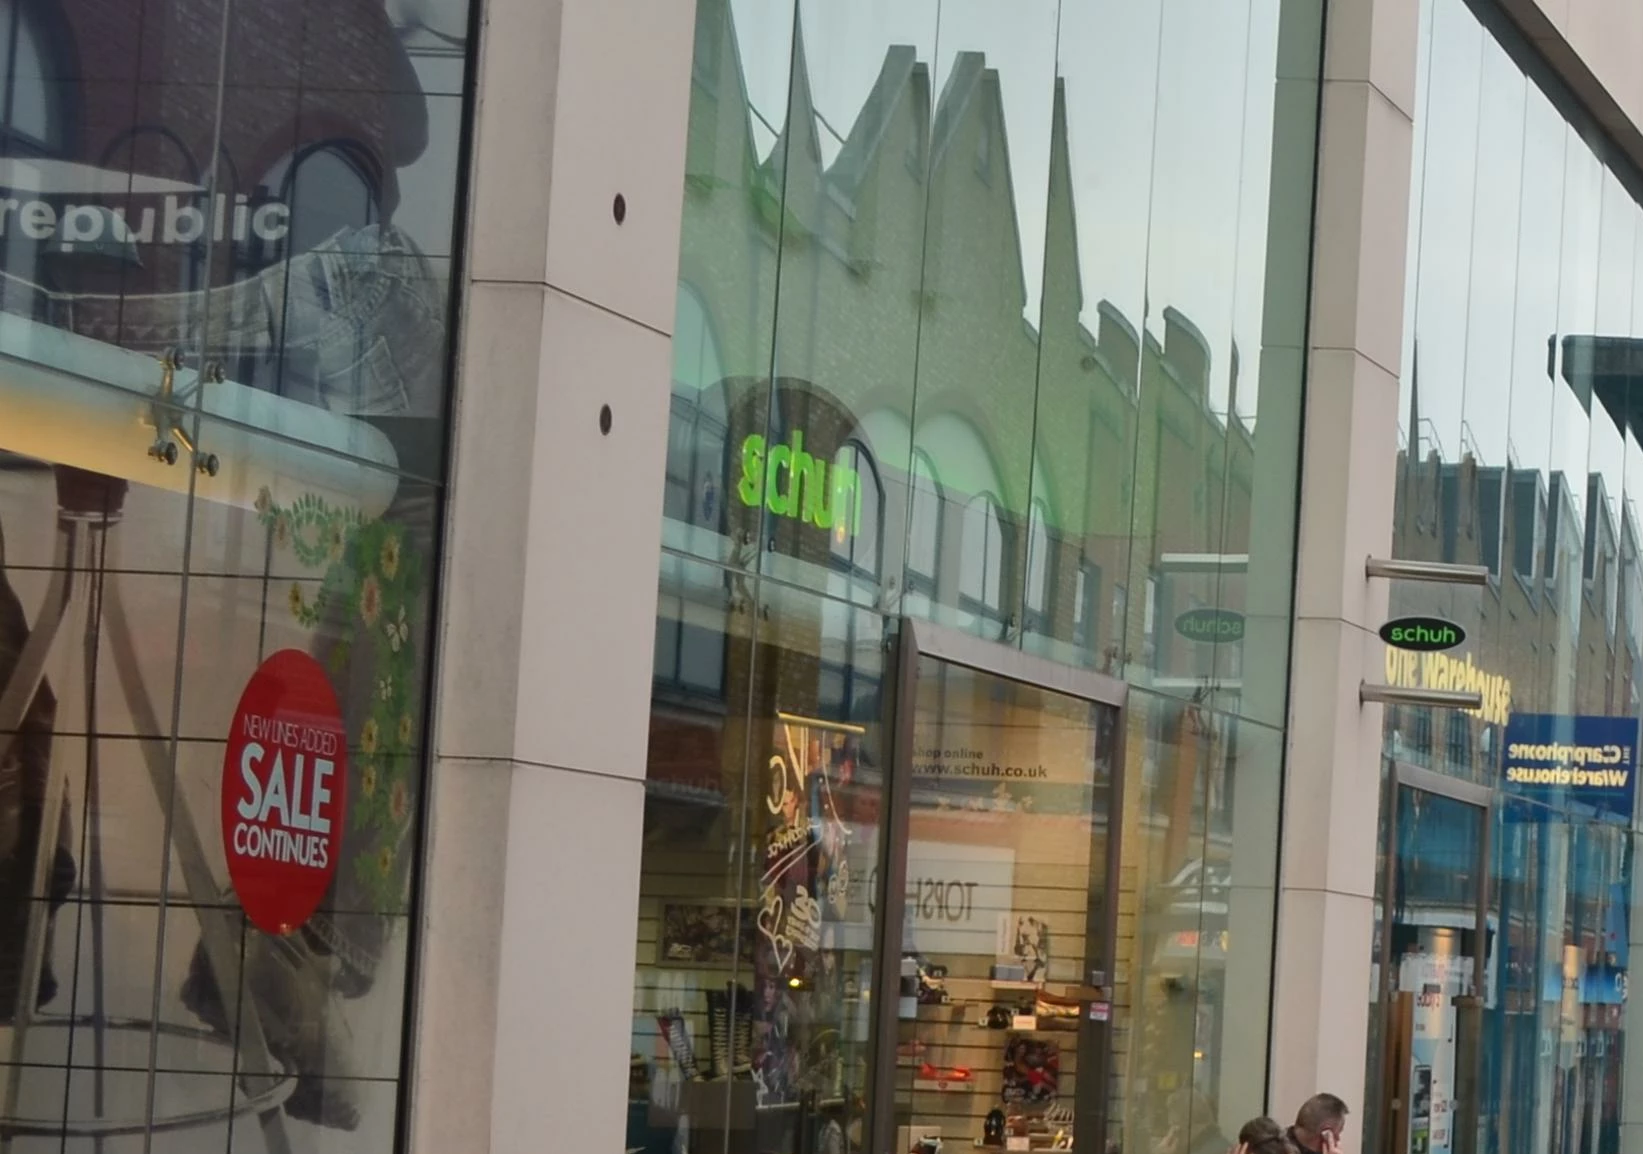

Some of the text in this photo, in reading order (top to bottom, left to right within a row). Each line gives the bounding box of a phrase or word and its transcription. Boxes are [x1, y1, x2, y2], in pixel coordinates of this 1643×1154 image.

[0, 193, 291, 253] republic
[737, 429, 862, 538] schuh
[1390, 625, 1456, 645] schuh
[243, 713, 337, 757] NEW LINES ADDED
[944, 748, 984, 760] online
[237, 741, 335, 834] SALE
[233, 822, 329, 869] CONTINUES
